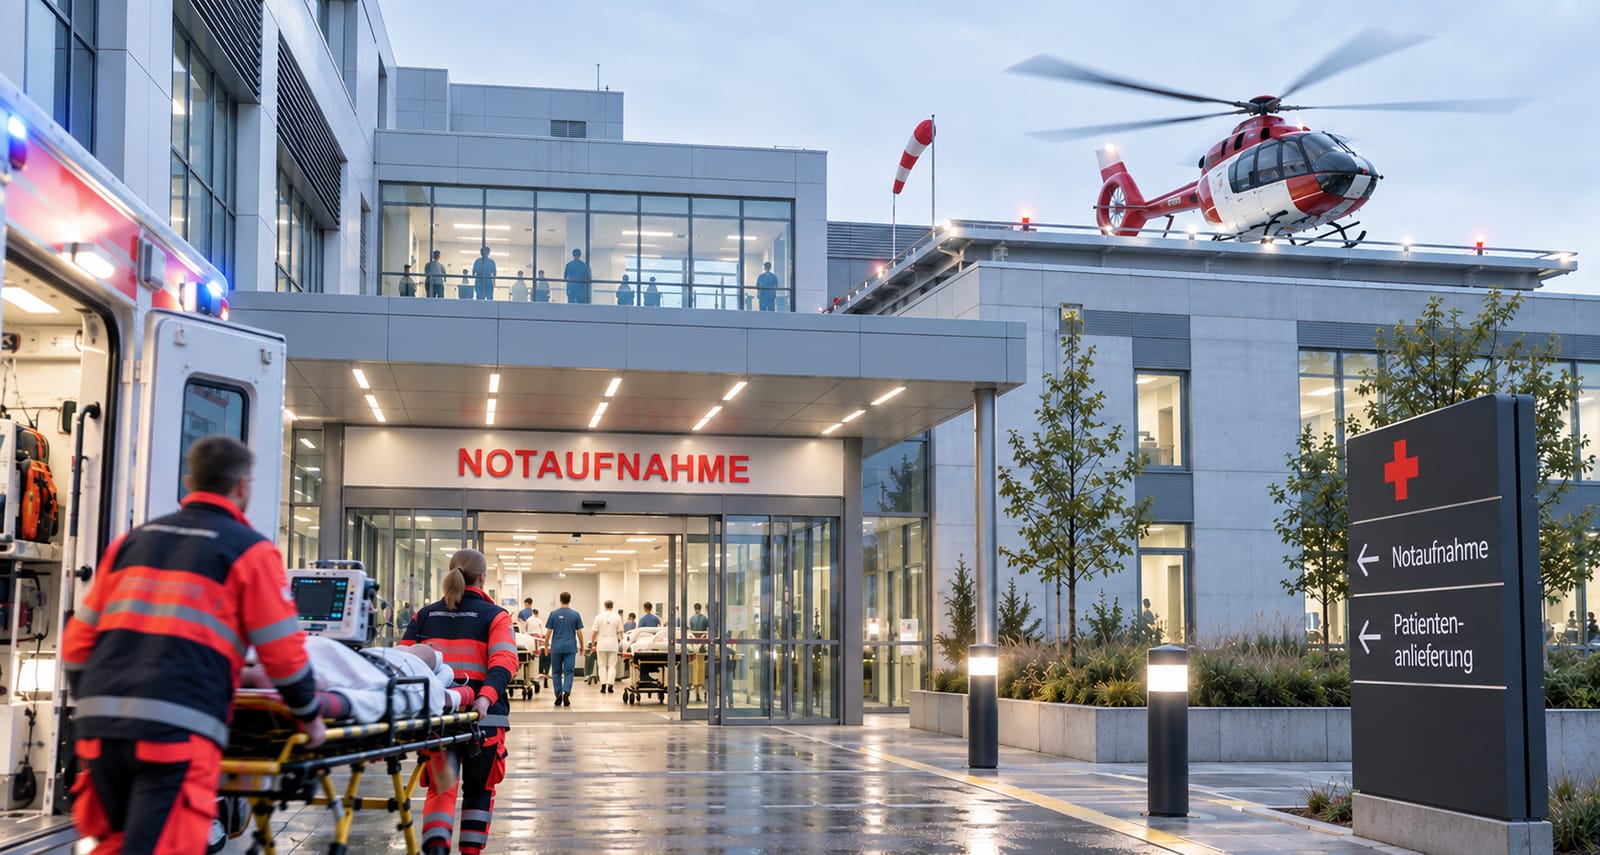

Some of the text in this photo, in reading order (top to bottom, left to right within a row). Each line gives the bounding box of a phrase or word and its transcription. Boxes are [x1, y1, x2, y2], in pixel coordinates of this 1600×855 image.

[458, 447, 750, 483] NOTAUFNAHME
[1391, 538, 1489, 569] Notaufnahme
[1394, 612, 1464, 635] Patienten-
[1394, 643, 1473, 674] anlieferung
